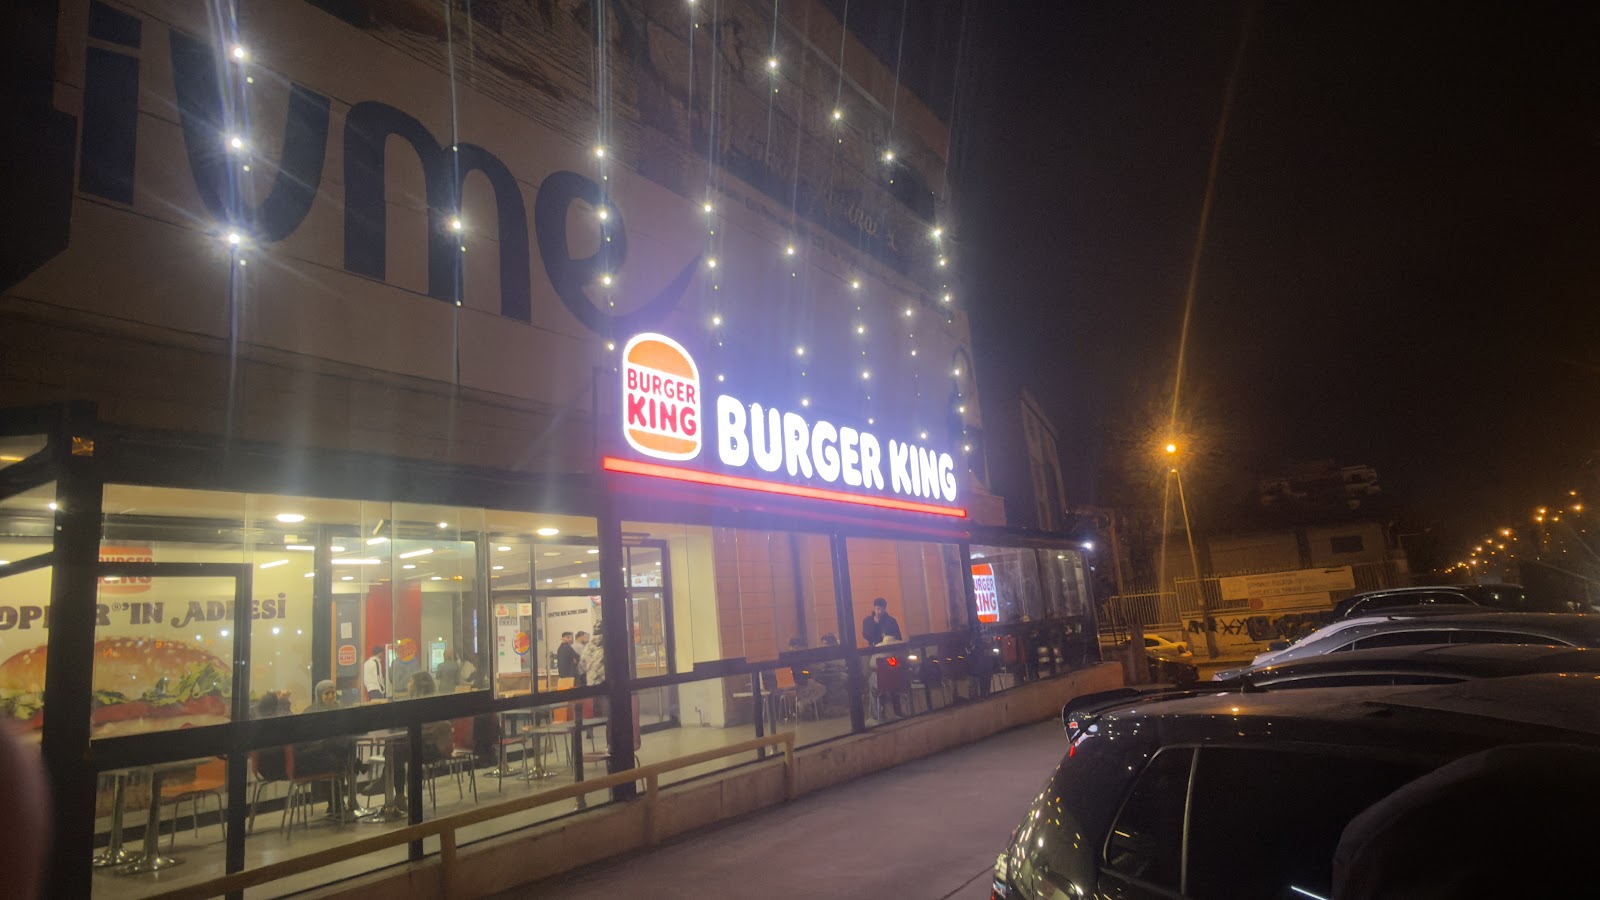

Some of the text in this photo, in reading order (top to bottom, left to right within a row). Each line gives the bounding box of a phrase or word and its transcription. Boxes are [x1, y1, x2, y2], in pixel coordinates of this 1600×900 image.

[626, 367, 697, 404] BURGER
[626, 392, 698, 437] KING
[716, 394, 957, 502] BURGER KING
[976, 592, 997, 612] ING
